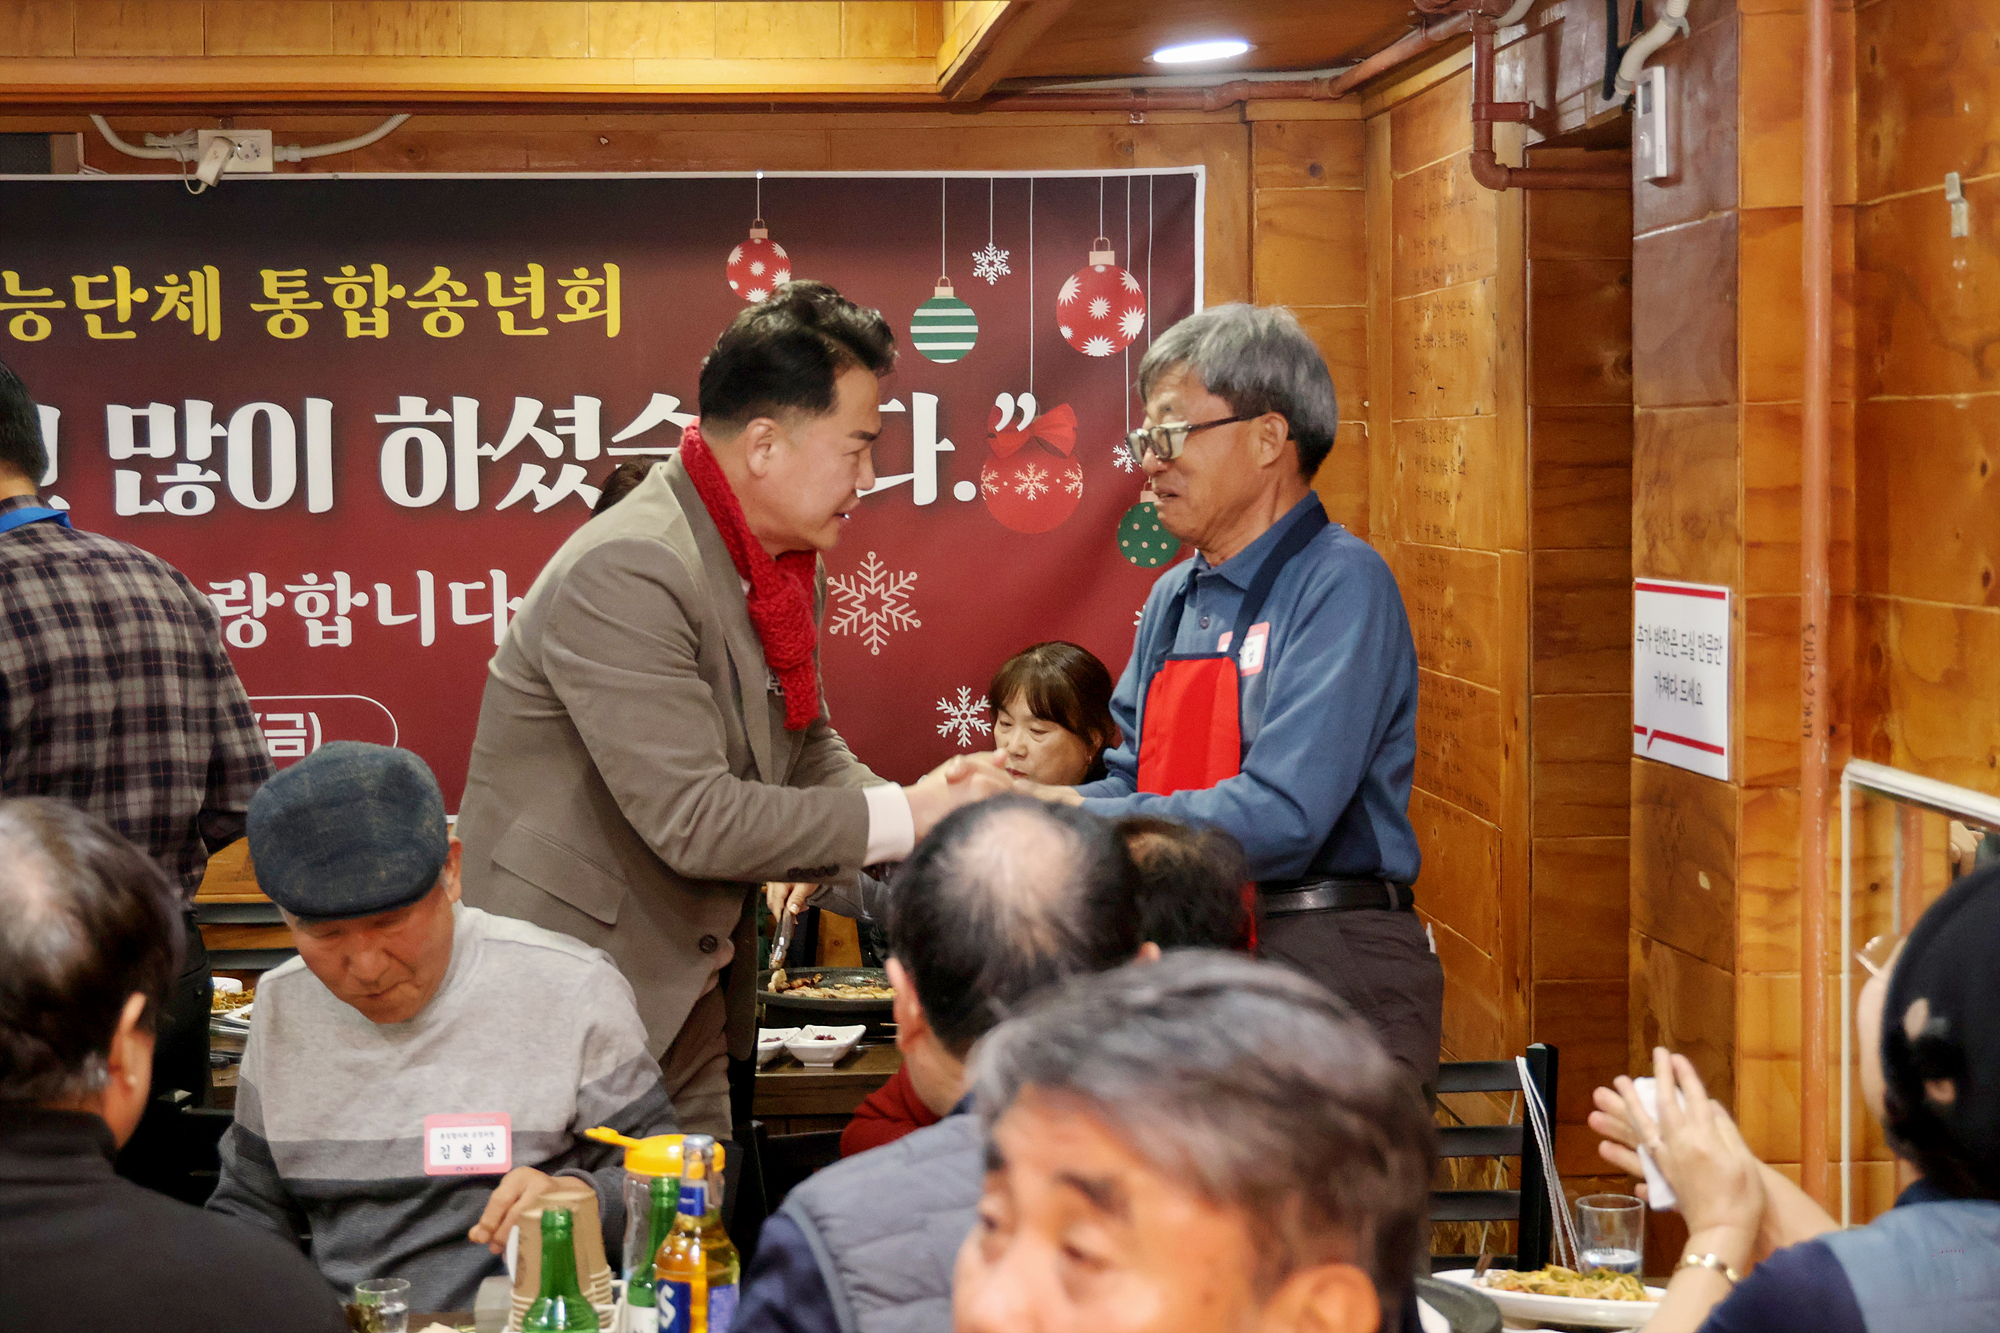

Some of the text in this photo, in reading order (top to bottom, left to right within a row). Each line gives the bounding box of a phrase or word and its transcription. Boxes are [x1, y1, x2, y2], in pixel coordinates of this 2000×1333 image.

[250, 262, 622, 340] 통합송년회
[106, 397, 334, 517] 많이
[1636, 623, 1723, 667] 추가 반찬은 드실 만큼만
[1679, 677, 1704, 707] 드세요
